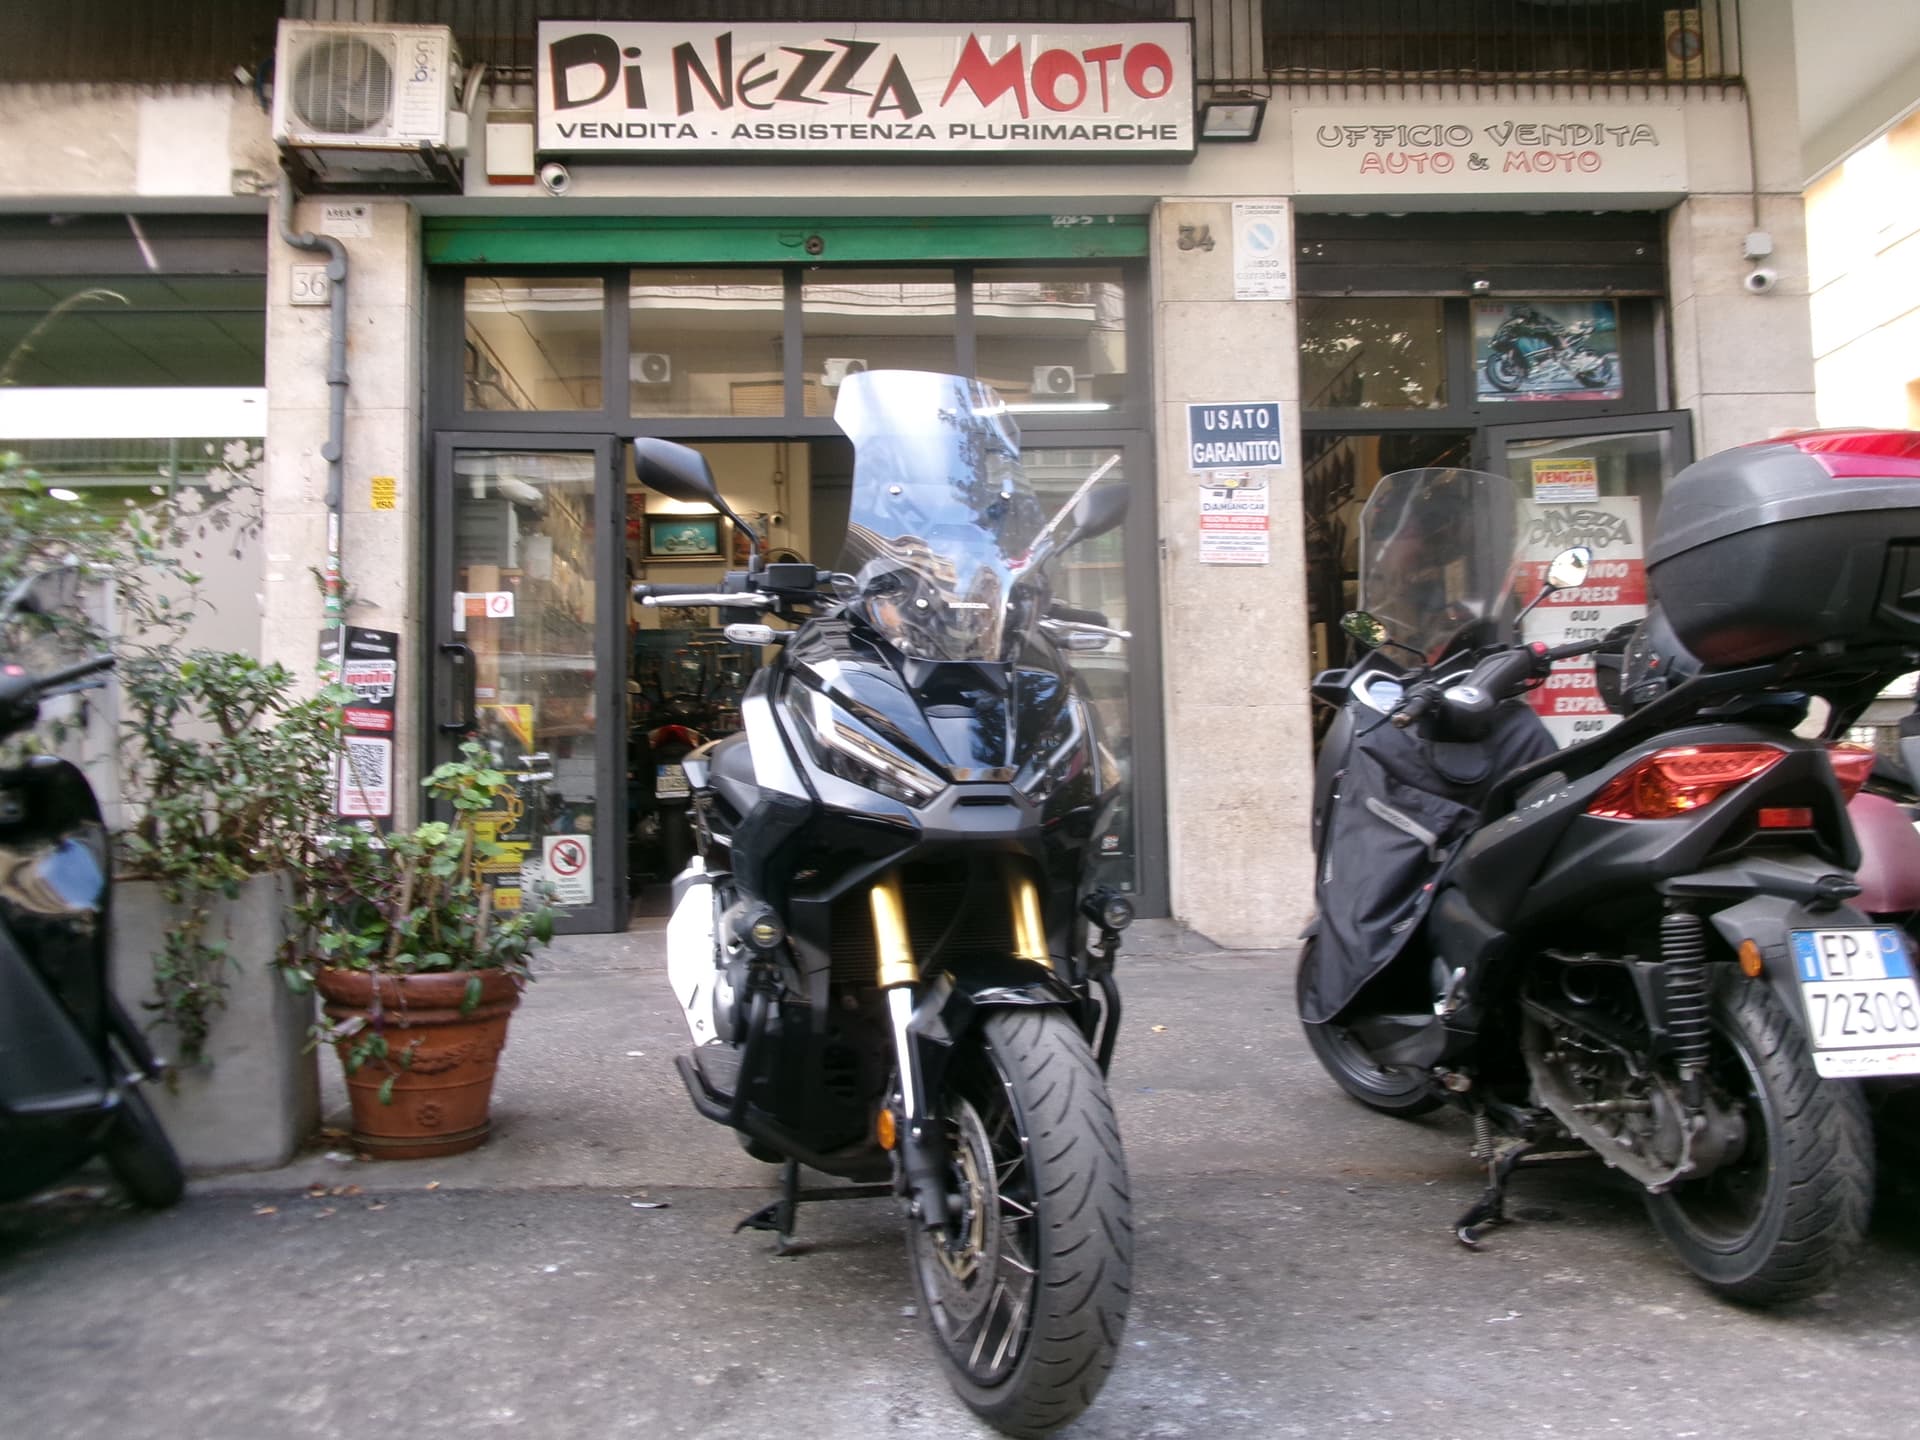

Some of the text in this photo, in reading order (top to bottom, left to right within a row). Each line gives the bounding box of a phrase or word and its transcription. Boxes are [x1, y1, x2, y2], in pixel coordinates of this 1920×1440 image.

[940, 32, 1174, 120] MOTO
[557, 122, 698, 139] VENDITA
[731, 123, 937, 140] ASSISTENZA
[949, 123, 1178, 140] PLURIMARCHE
[1316, 121, 1660, 148] UFFICIO VENDITA
[1360, 150, 1602, 175] AUTO & MOTO
[294, 271, 327, 297] 36
[1203, 408, 1270, 431] USATO
[1193, 440, 1281, 463] GARANTITO
[1821, 934, 1860, 977] EP
[1812, 991, 1919, 1038] 72308
